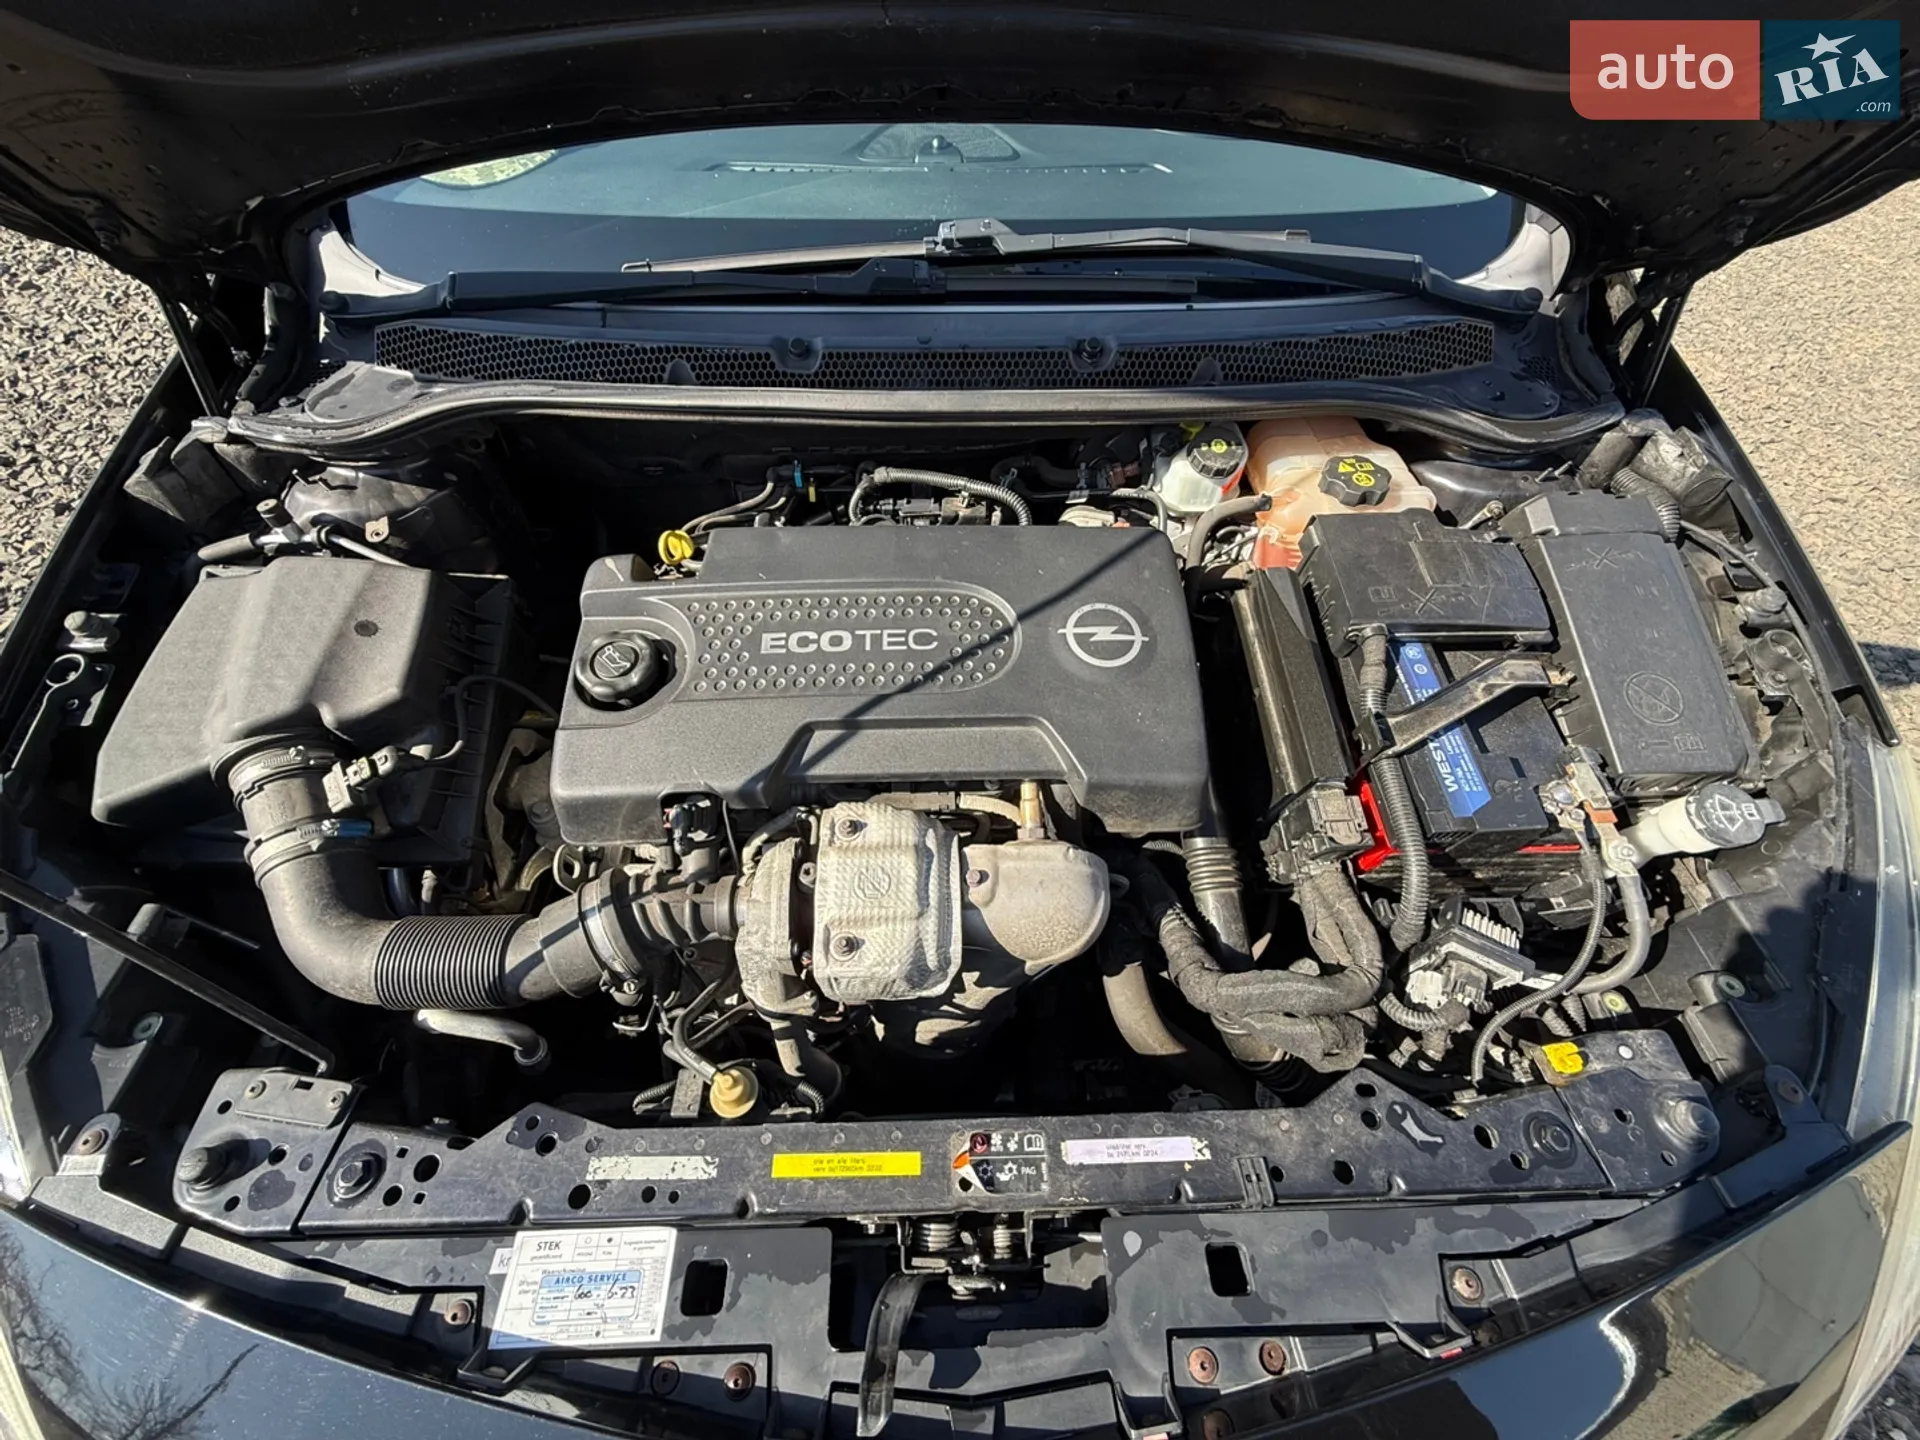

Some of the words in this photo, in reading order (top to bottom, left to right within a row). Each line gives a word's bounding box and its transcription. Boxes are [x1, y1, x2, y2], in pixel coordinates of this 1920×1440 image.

[760, 627, 938, 654] ECOTEC
[536, 1240, 562, 1252] STEK
[554, 1275, 584, 1285] AIRCO
[587, 1273, 627, 1283] SERVICE
